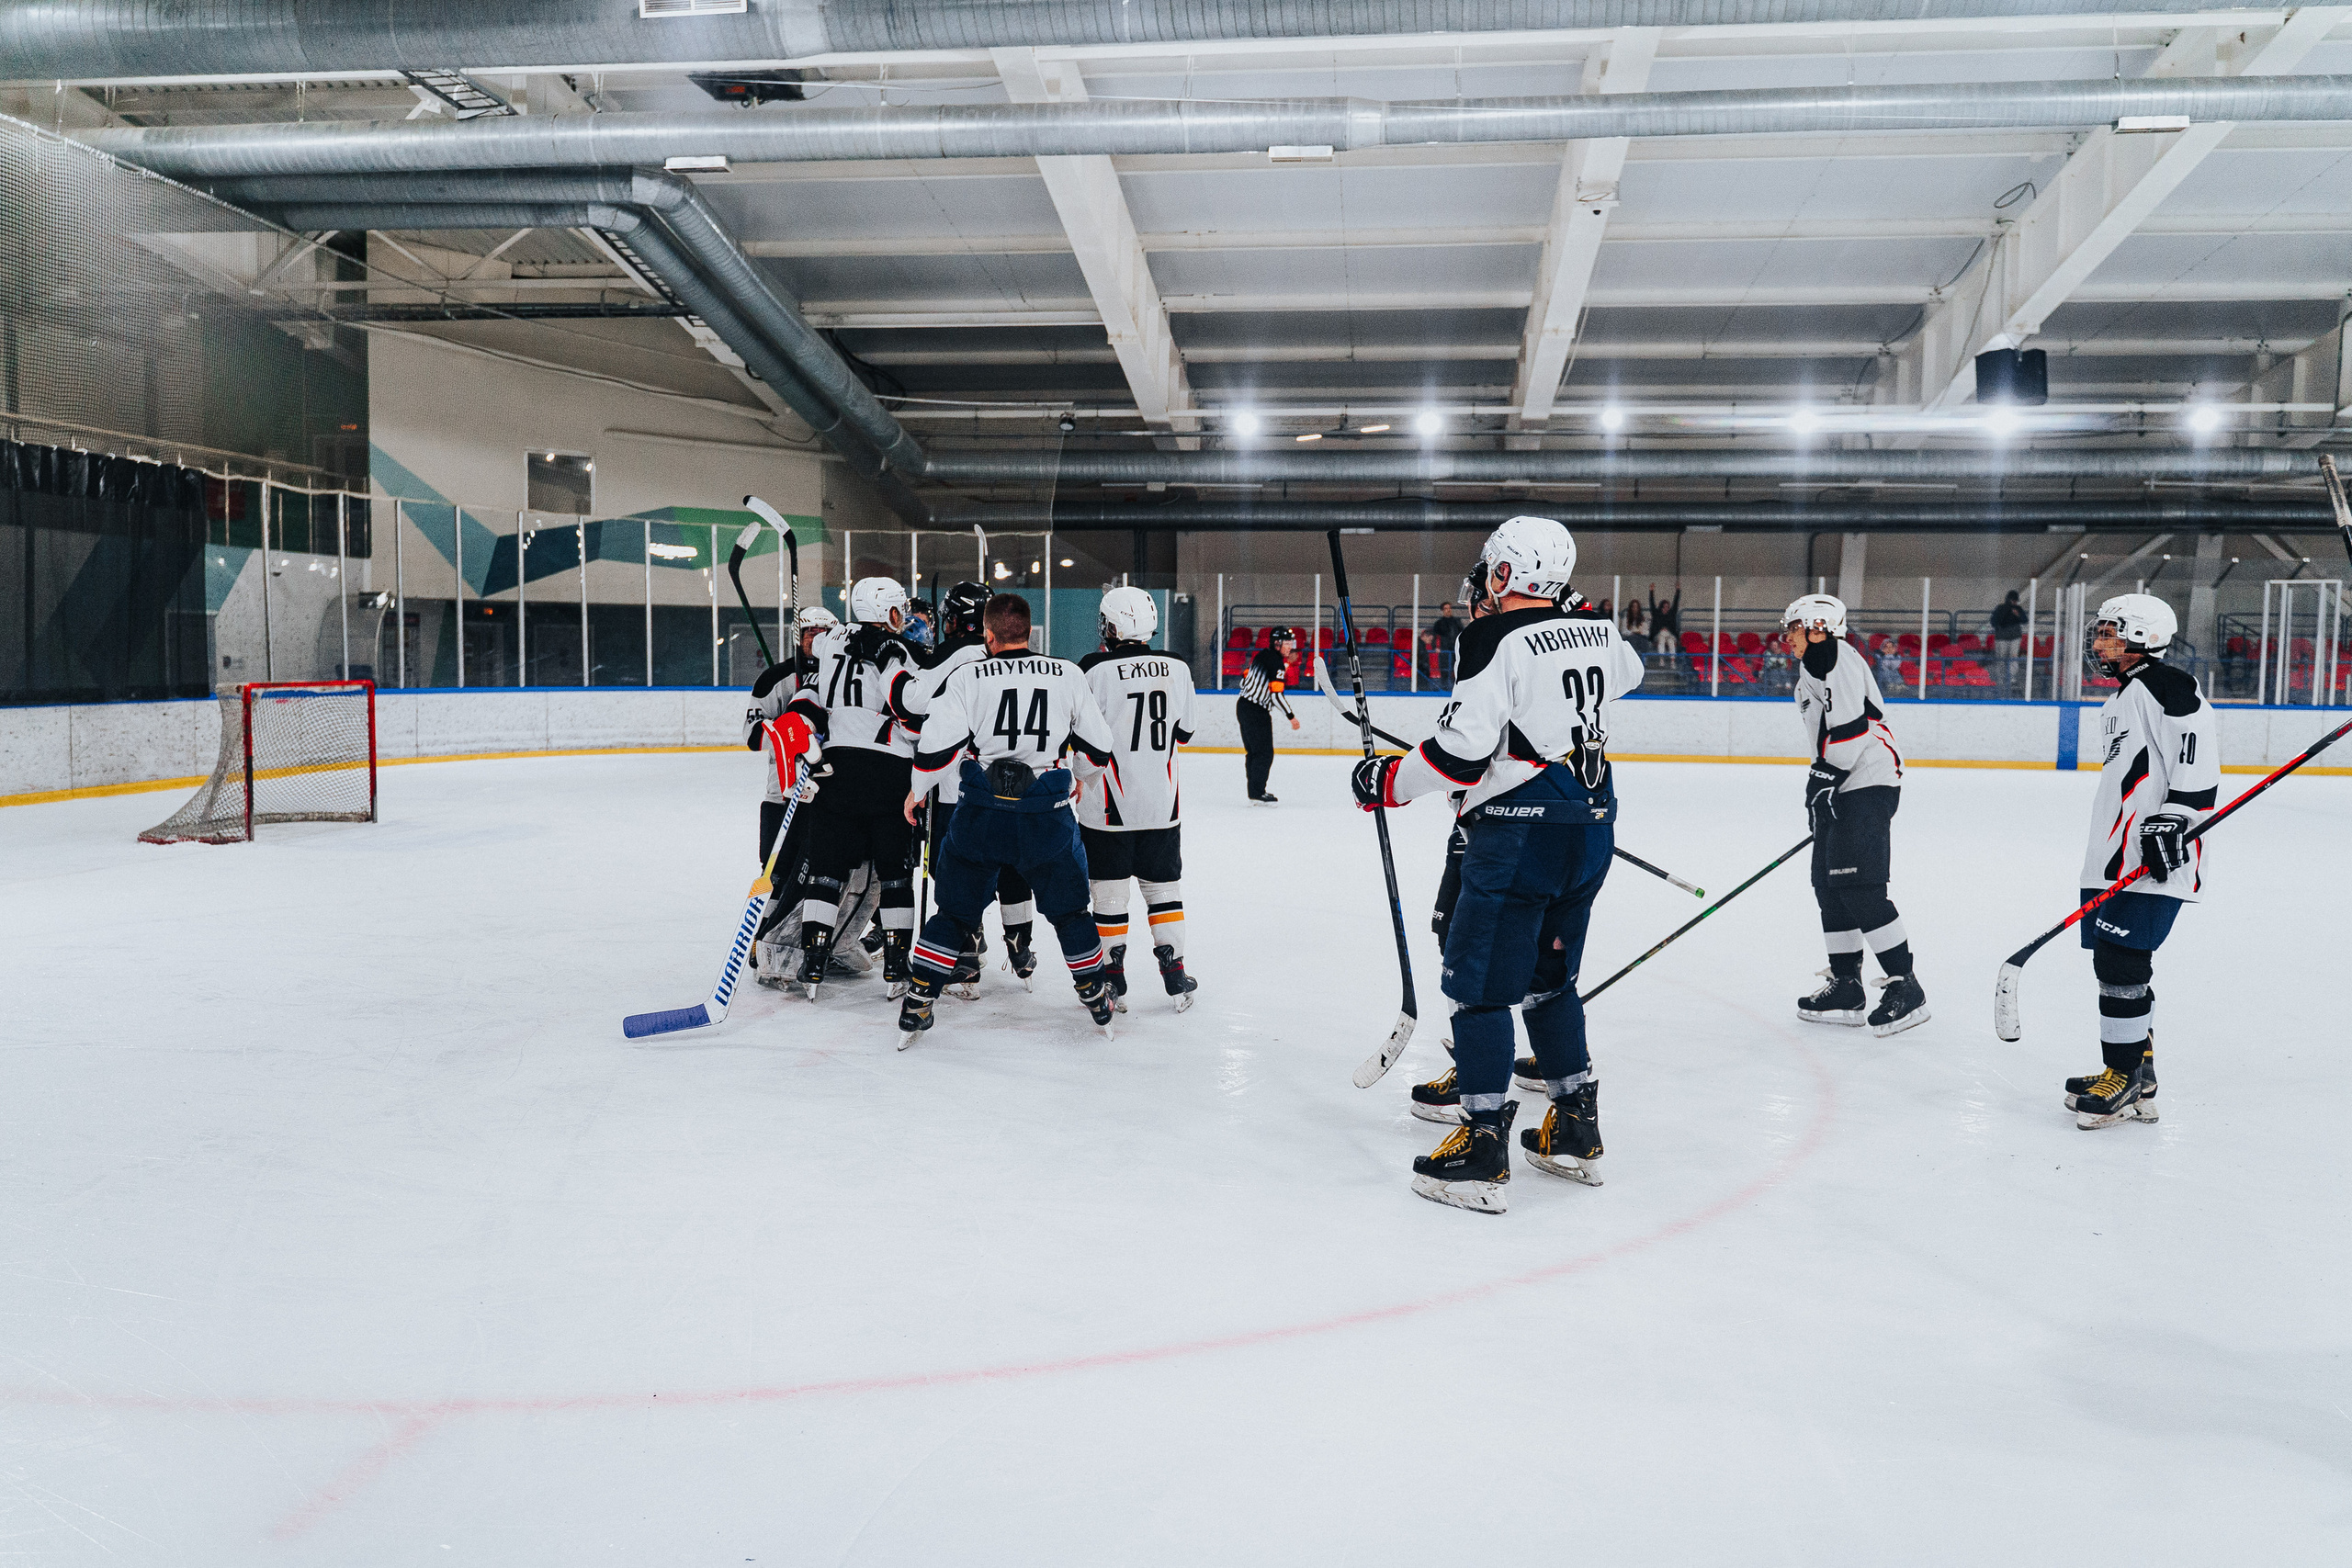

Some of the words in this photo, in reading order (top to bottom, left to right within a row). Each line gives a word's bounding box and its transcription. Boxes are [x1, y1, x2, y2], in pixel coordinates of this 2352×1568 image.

[1541, 580, 1565, 596] 77
[1523, 626, 1609, 656] ИВАНИН
[974, 660, 1063, 679] НАУМОВ
[1116, 661, 1170, 680] ЕЖОВ
[826, 653, 864, 708] 76
[992, 687, 1050, 752] 44
[1126, 690, 1168, 752] 78
[1810, 768, 1836, 781] TON
[1485, 805, 1545, 818] BAUER
[2095, 917, 2131, 938] CCM
[714, 895, 766, 1008] WARRIOR
